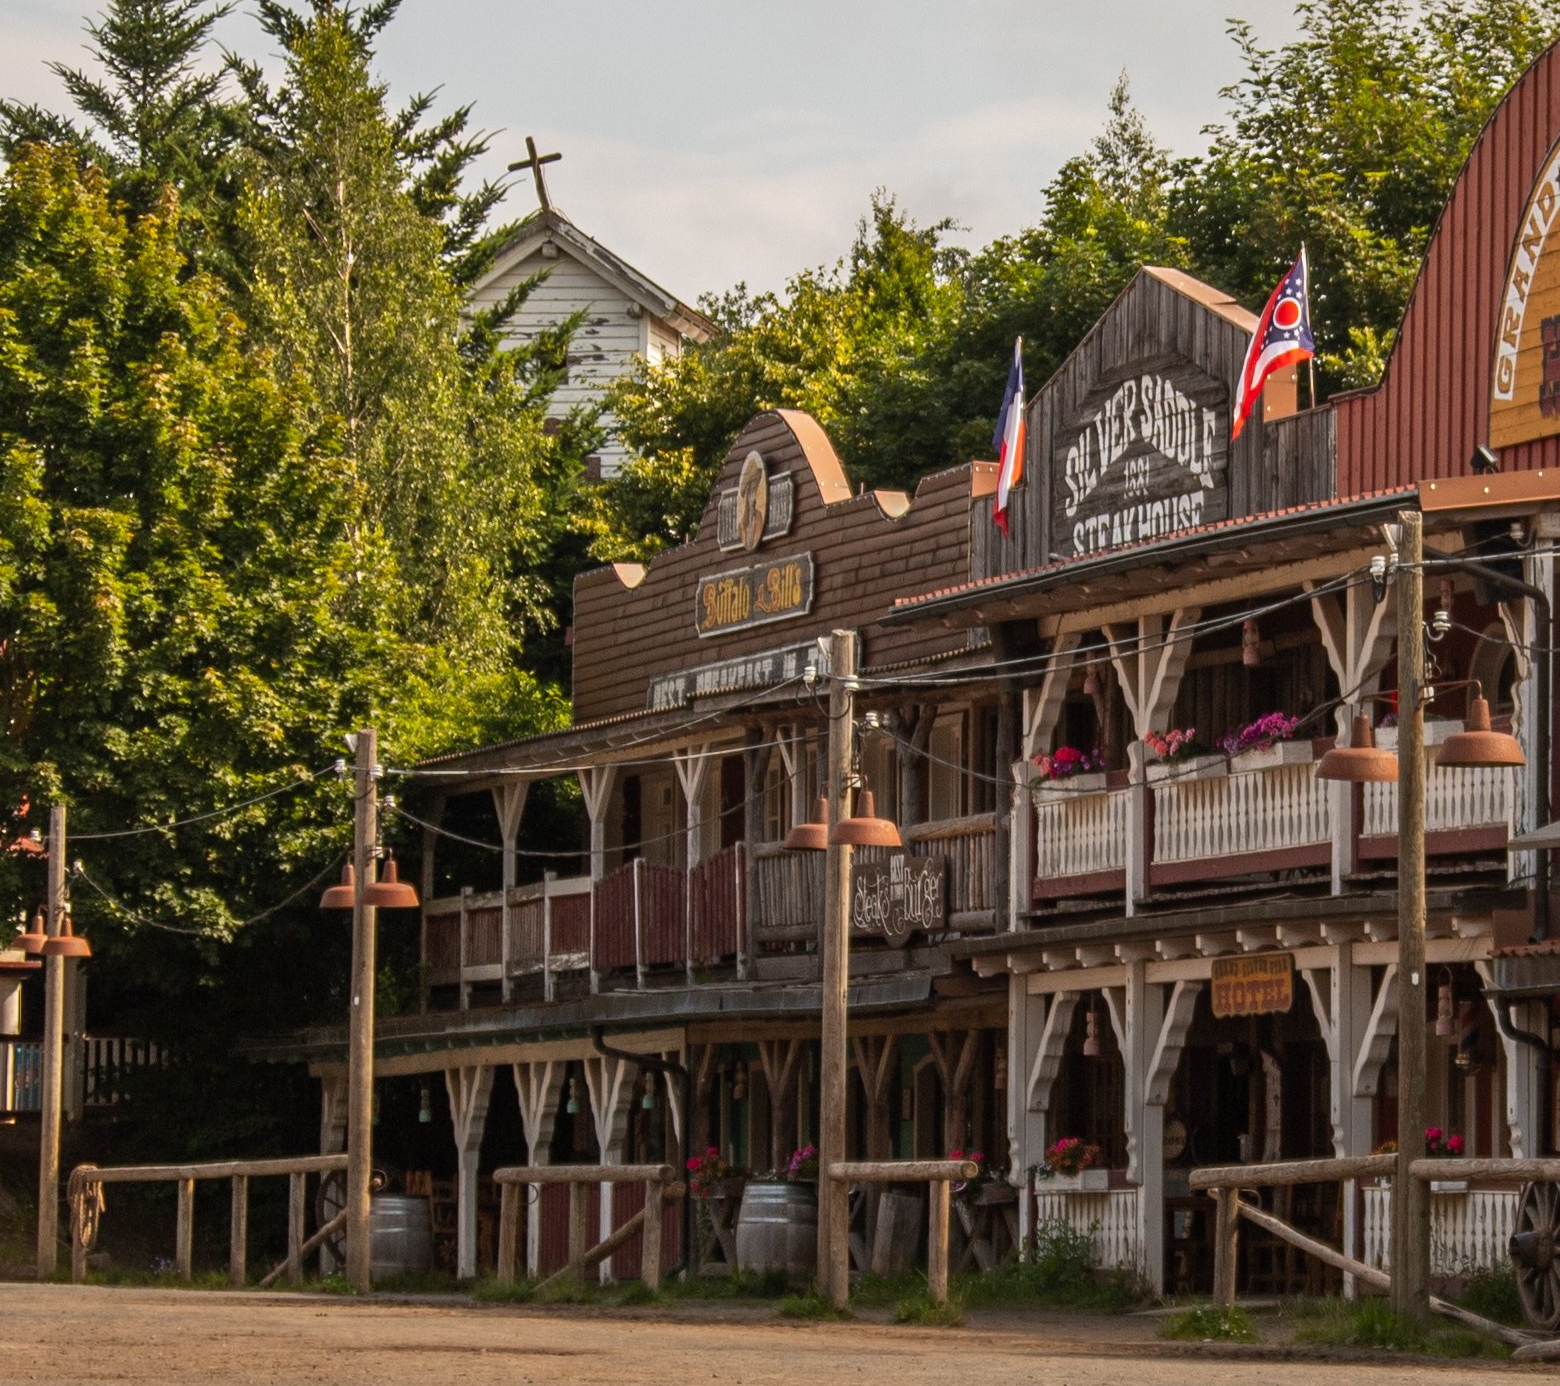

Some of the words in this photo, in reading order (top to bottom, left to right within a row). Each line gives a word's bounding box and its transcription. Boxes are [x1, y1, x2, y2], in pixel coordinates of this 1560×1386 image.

[1495, 180, 1557, 396] GRAND
[1065, 379, 1137, 517] SILVER
[1140, 374, 1216, 489] SADDLE
[701, 576, 750, 630] Buffalo
[1215, 978, 1290, 1013] HOTEL
